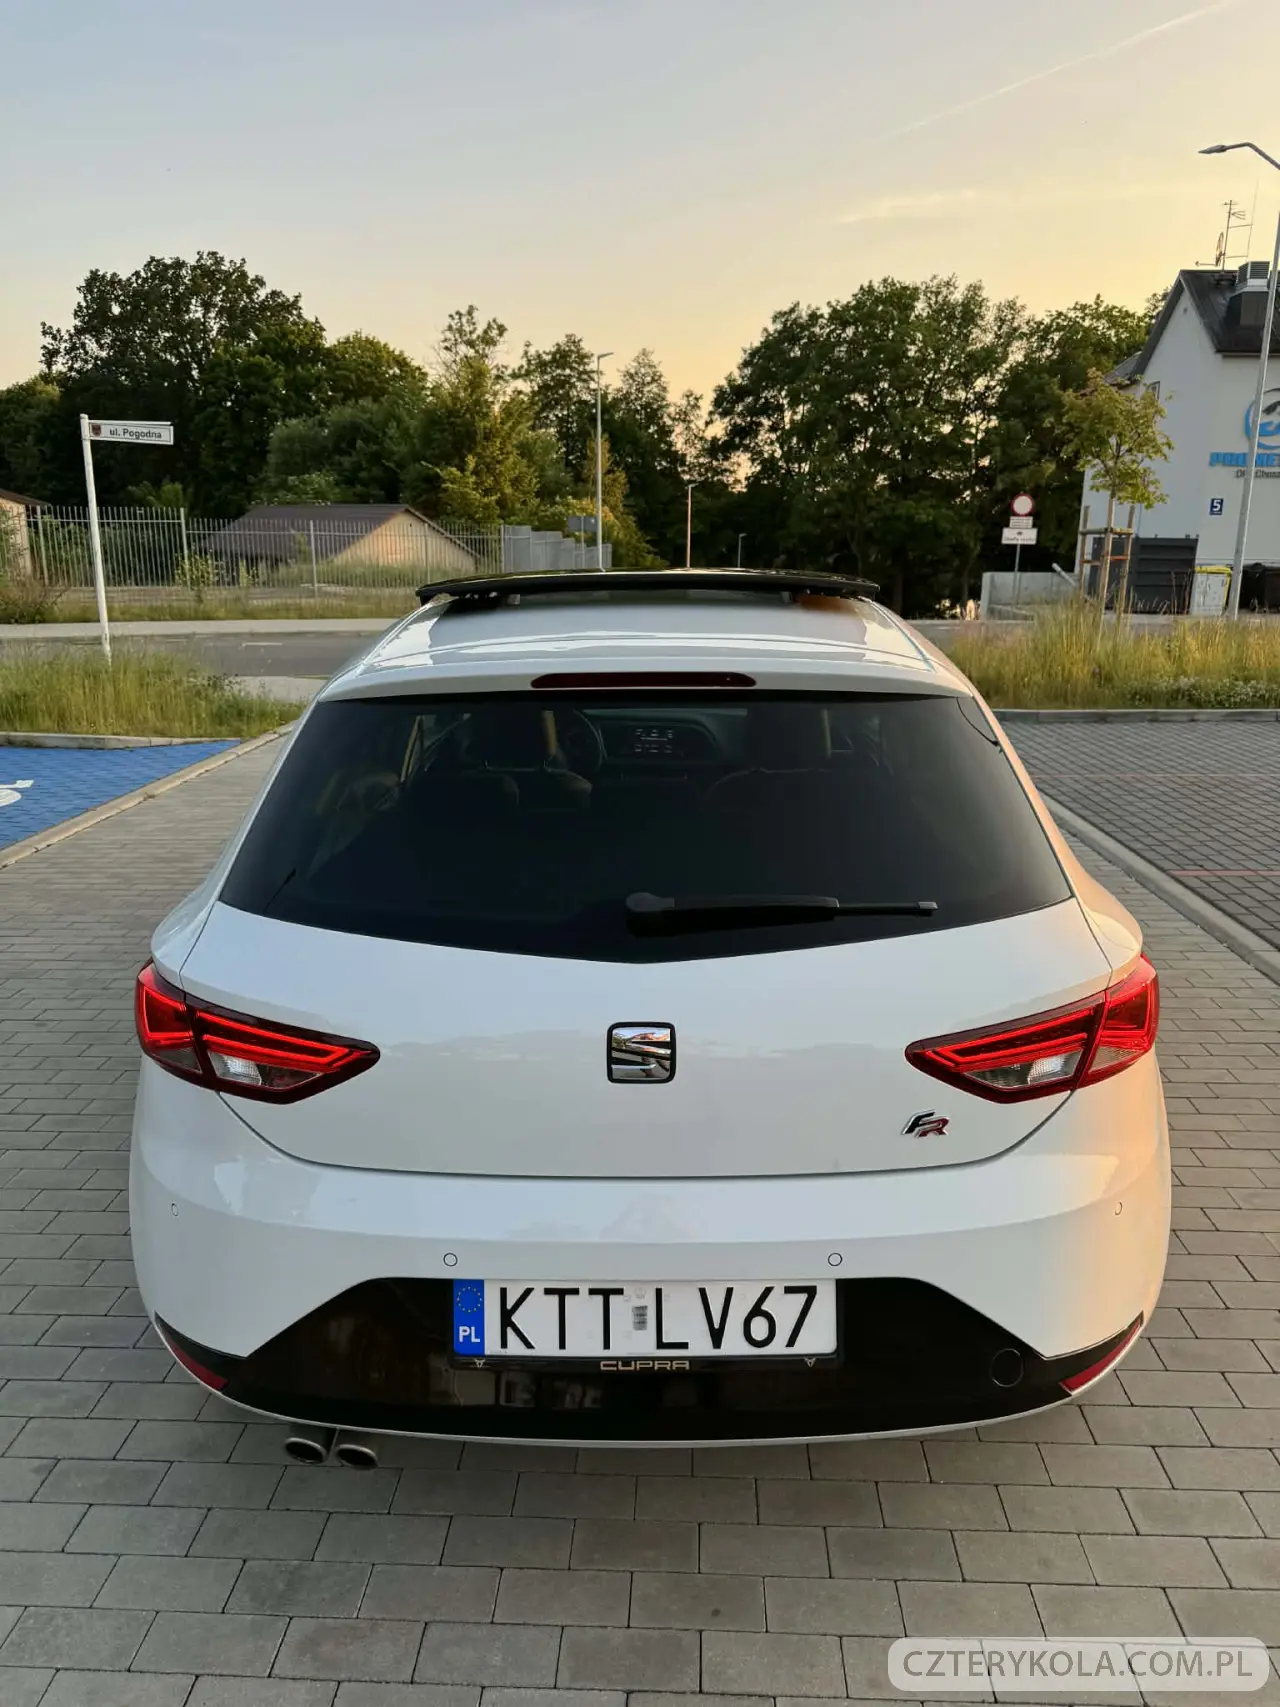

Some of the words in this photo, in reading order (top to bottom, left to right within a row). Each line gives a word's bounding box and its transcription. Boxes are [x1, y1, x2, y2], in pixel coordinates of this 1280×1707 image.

[109, 428, 120, 437] ul.
[123, 428, 162, 440] Pogodna
[1212, 499, 1221, 512] 5
[499, 1287, 625, 1350] KTT
[655, 1285, 817, 1350] LV67
[458, 1326, 481, 1343] PL
[599, 1360, 690, 1372] CUPRA
